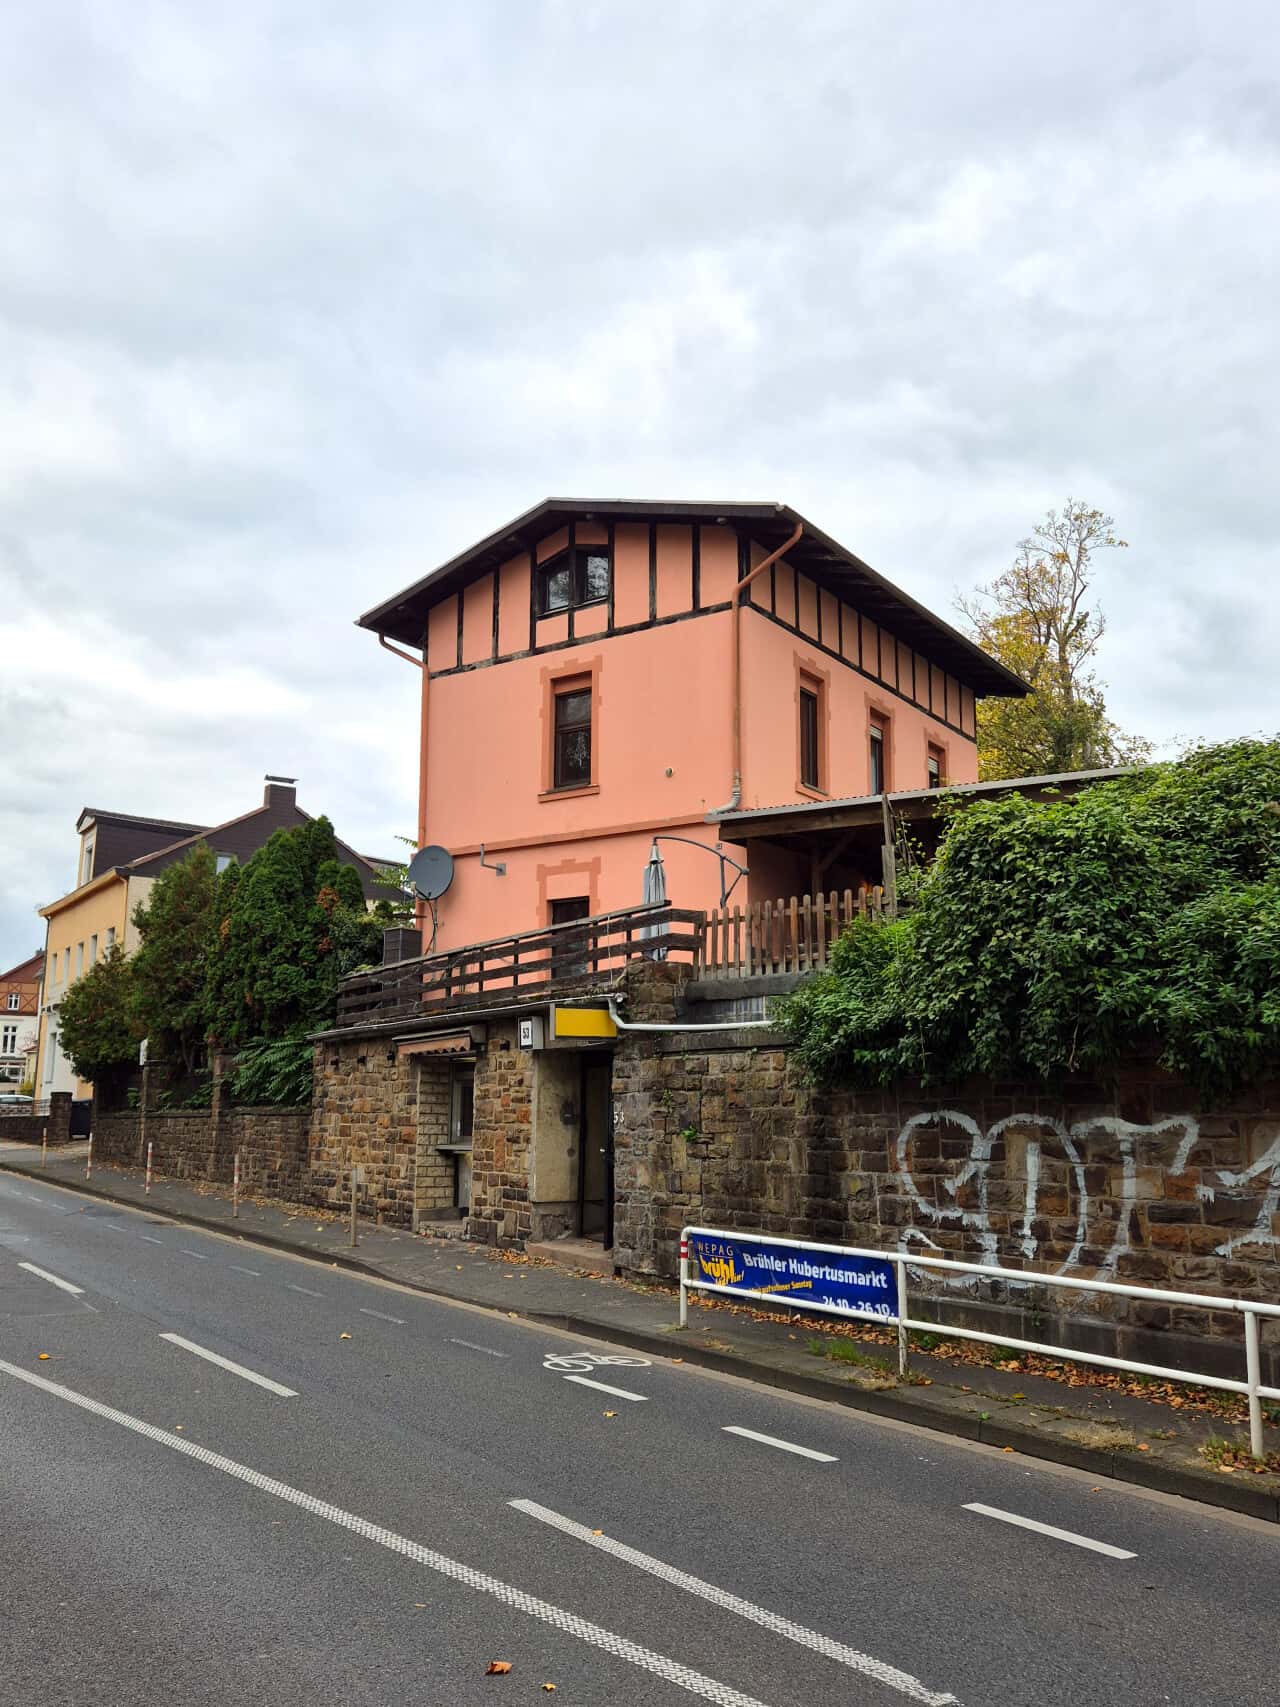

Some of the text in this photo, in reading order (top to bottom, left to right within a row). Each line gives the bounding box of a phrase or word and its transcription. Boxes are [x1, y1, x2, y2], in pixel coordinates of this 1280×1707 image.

[522, 1027, 530, 1040] 53
[613, 1111, 625, 1124] 53
[699, 1254, 735, 1281] brühl
[742, 1252, 888, 1289] Brühler Hubertusmarkt
